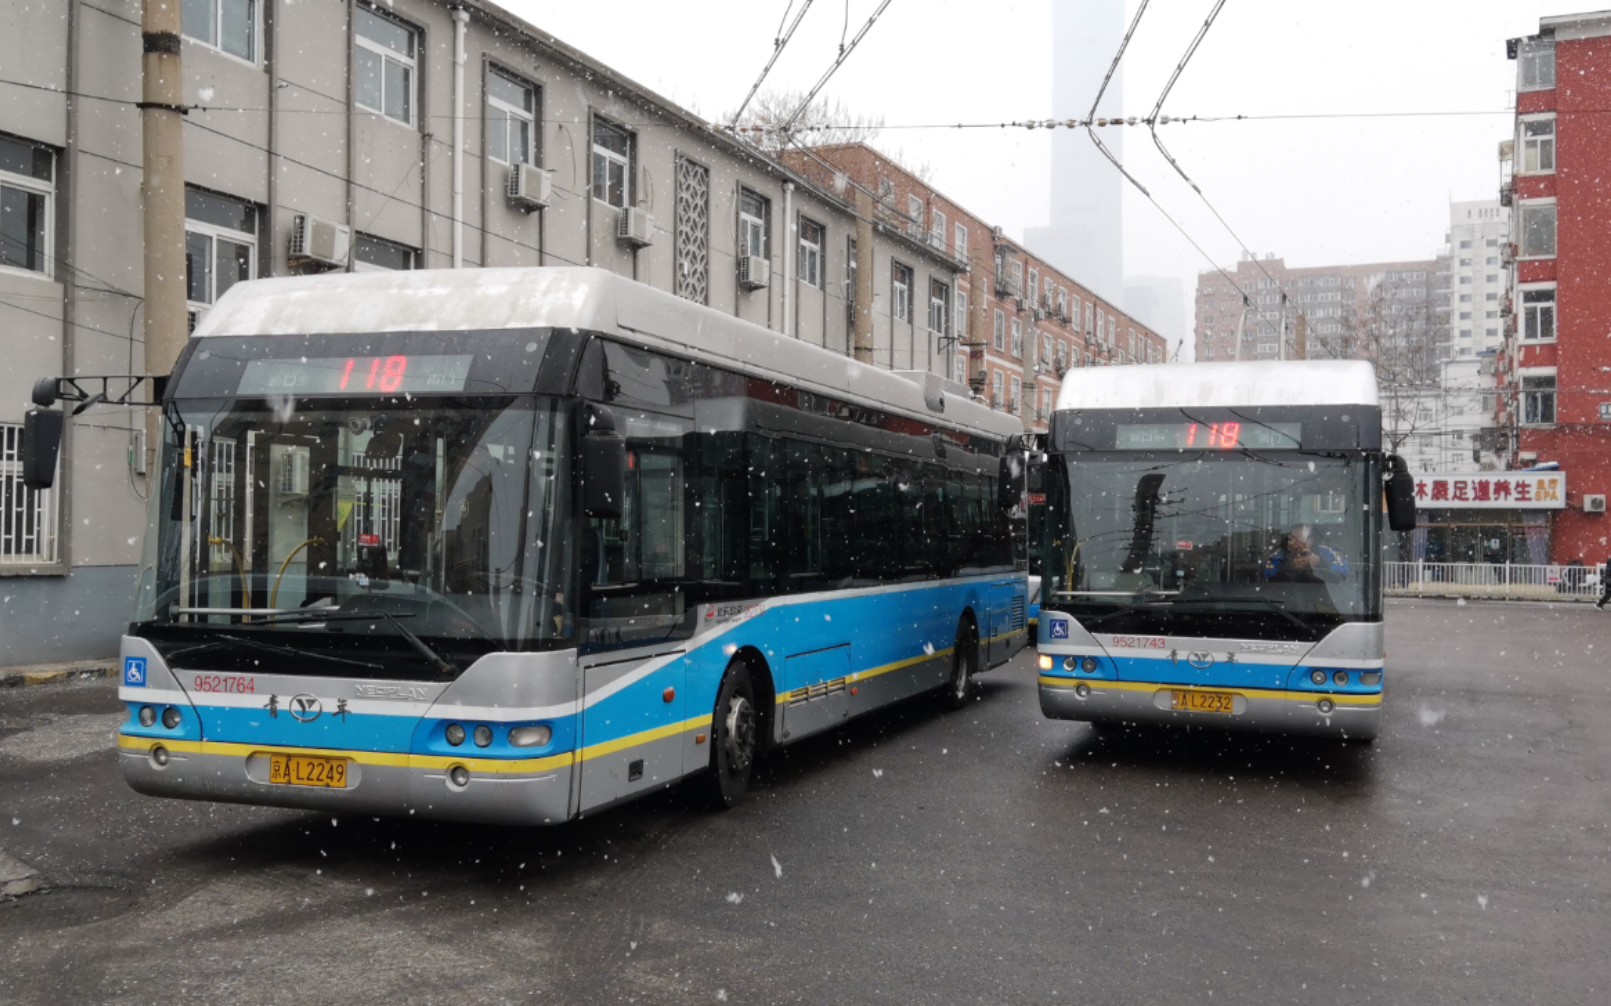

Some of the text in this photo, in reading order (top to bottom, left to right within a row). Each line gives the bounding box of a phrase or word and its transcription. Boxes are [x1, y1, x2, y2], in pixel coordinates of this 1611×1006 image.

[339, 354, 408, 393] 118
[1186, 421, 1241, 449] 118
[1535, 489, 1559, 501] SPA
[1112, 635, 1166, 649] 9521743
[194, 675, 256, 694] 9521764
